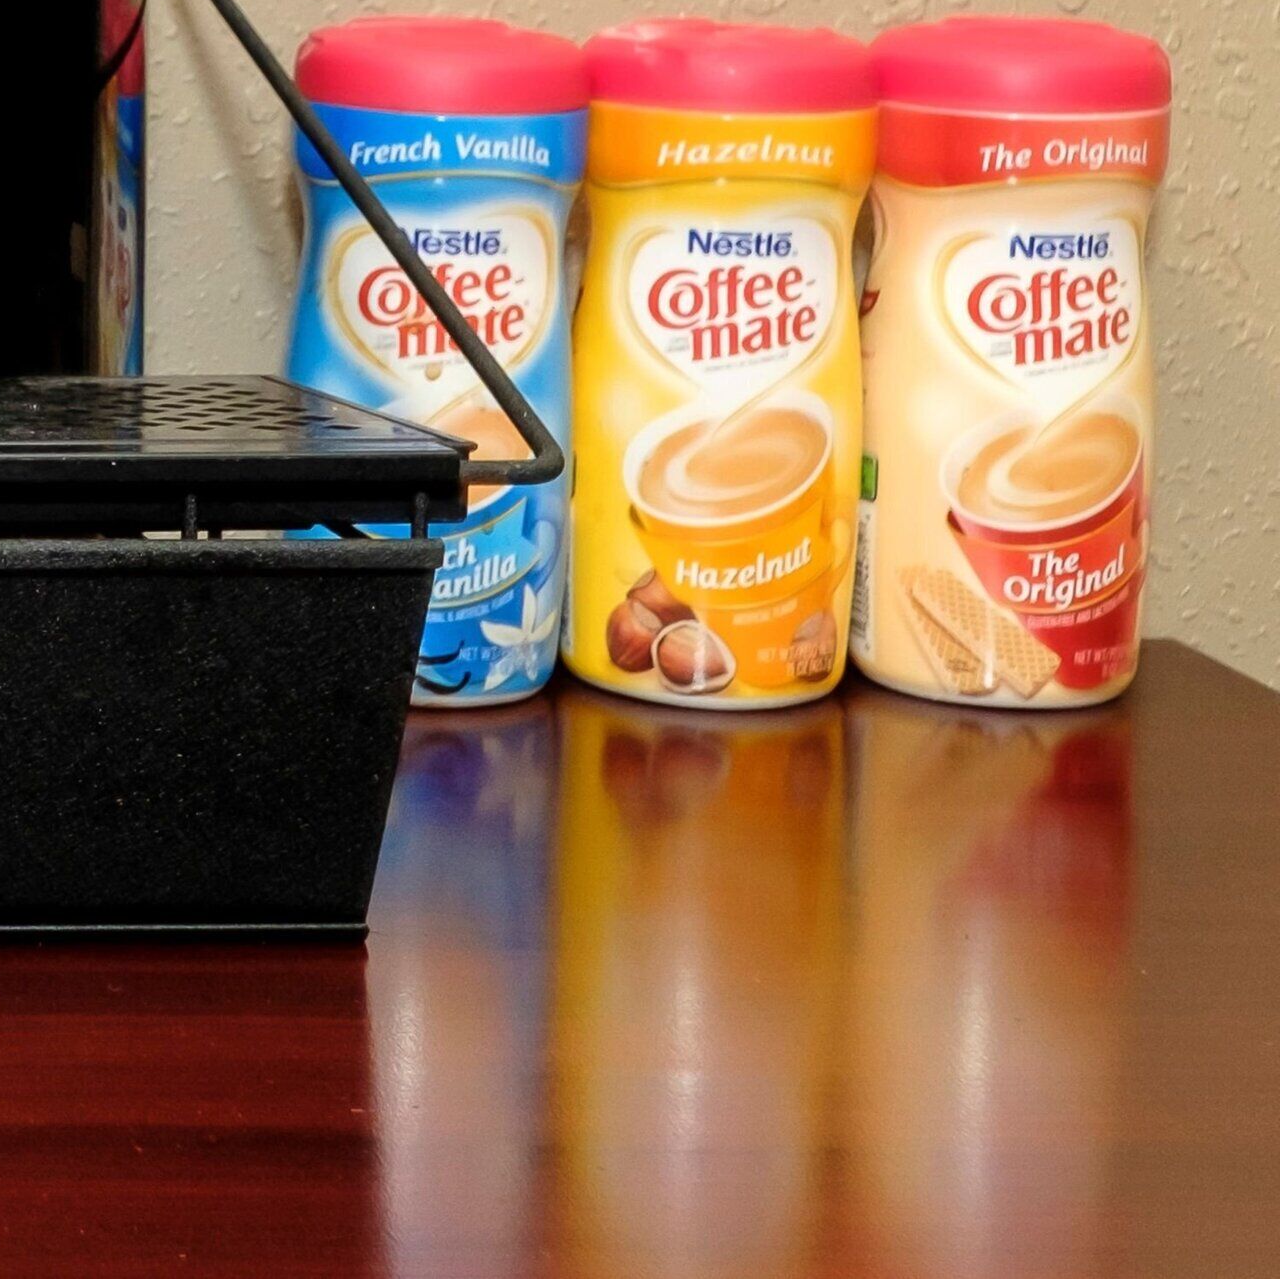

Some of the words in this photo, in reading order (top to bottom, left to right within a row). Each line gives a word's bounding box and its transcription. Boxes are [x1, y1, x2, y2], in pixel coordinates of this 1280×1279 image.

[350, 132, 440, 166] French
[455, 133, 550, 167] Vanilla
[656, 134, 835, 168] Hazelnut
[980, 142, 1032, 172] The
[1043, 137, 1148, 170] Original
[691, 303, 816, 361] mate
[1012, 307, 1130, 365] mate
[434, 553, 517, 599] anilla
[675, 537, 811, 590] Hazelnut
[1003, 543, 1125, 611] Original
[1028, 550, 1080, 577] The
